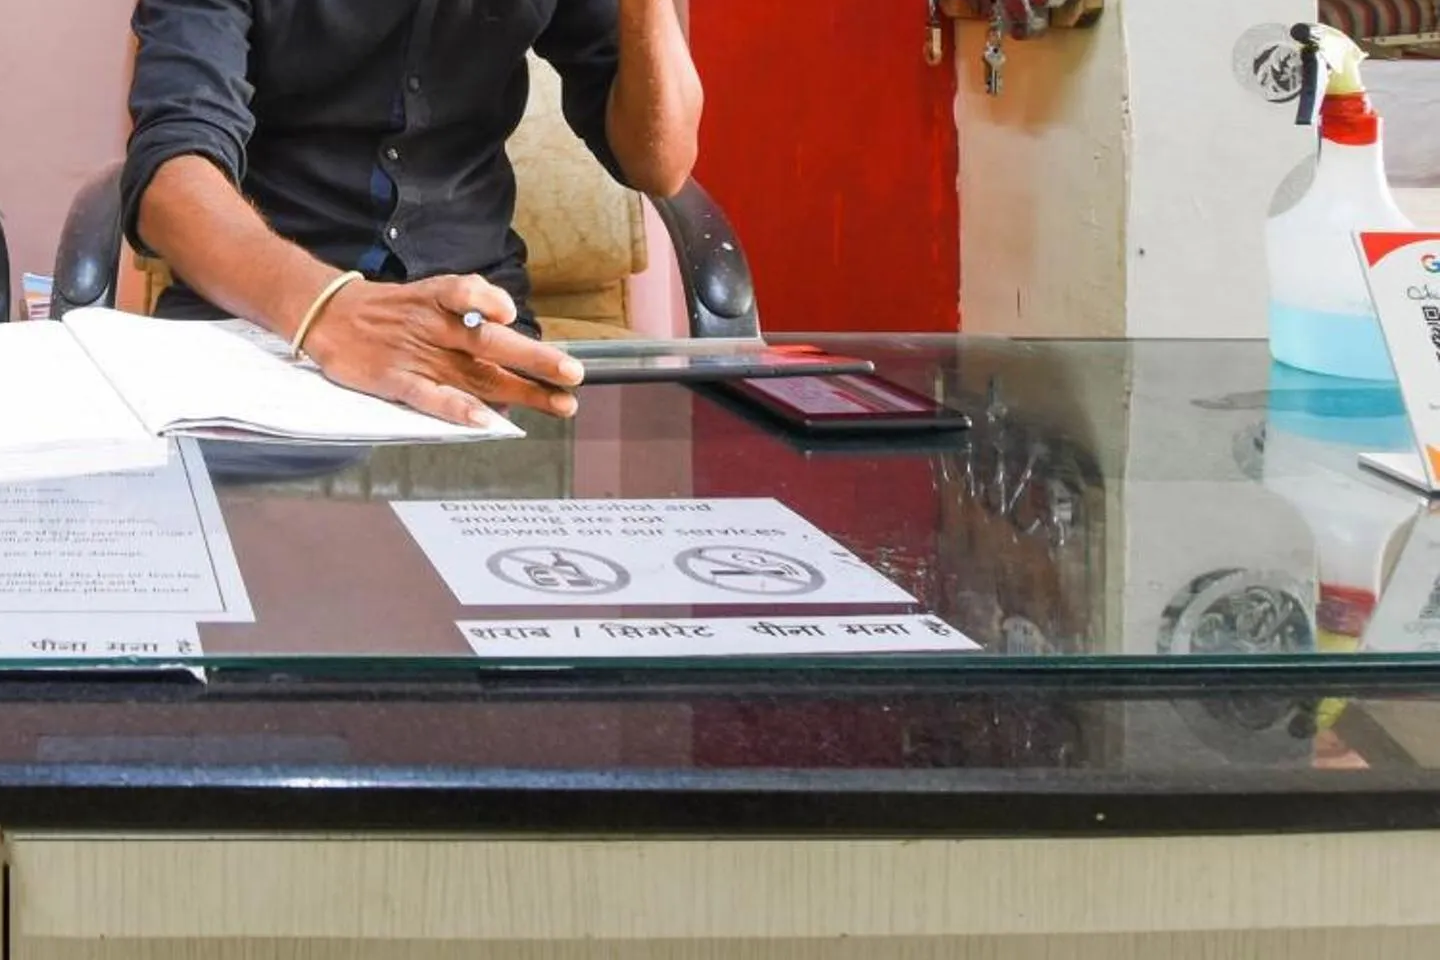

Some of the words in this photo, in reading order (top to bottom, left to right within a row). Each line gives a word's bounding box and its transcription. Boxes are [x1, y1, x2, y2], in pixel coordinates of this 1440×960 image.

[440, 502, 553, 513] Drinking
[558, 503, 656, 512] alcohol
[664, 503, 712, 512] and
[450, 515, 562, 525] smoking
[570, 516, 614, 524] are
[620, 516, 664, 524] not
[461, 527, 569, 536] allowed
[576, 528, 613, 536] on
[620, 528, 665, 536] our
[675, 527, 787, 537] services
[468, 626, 552, 641] शराब
[598, 622, 716, 640] सिगरेट
[746, 621, 826, 637] पीना
[838, 623, 911, 637] मना
